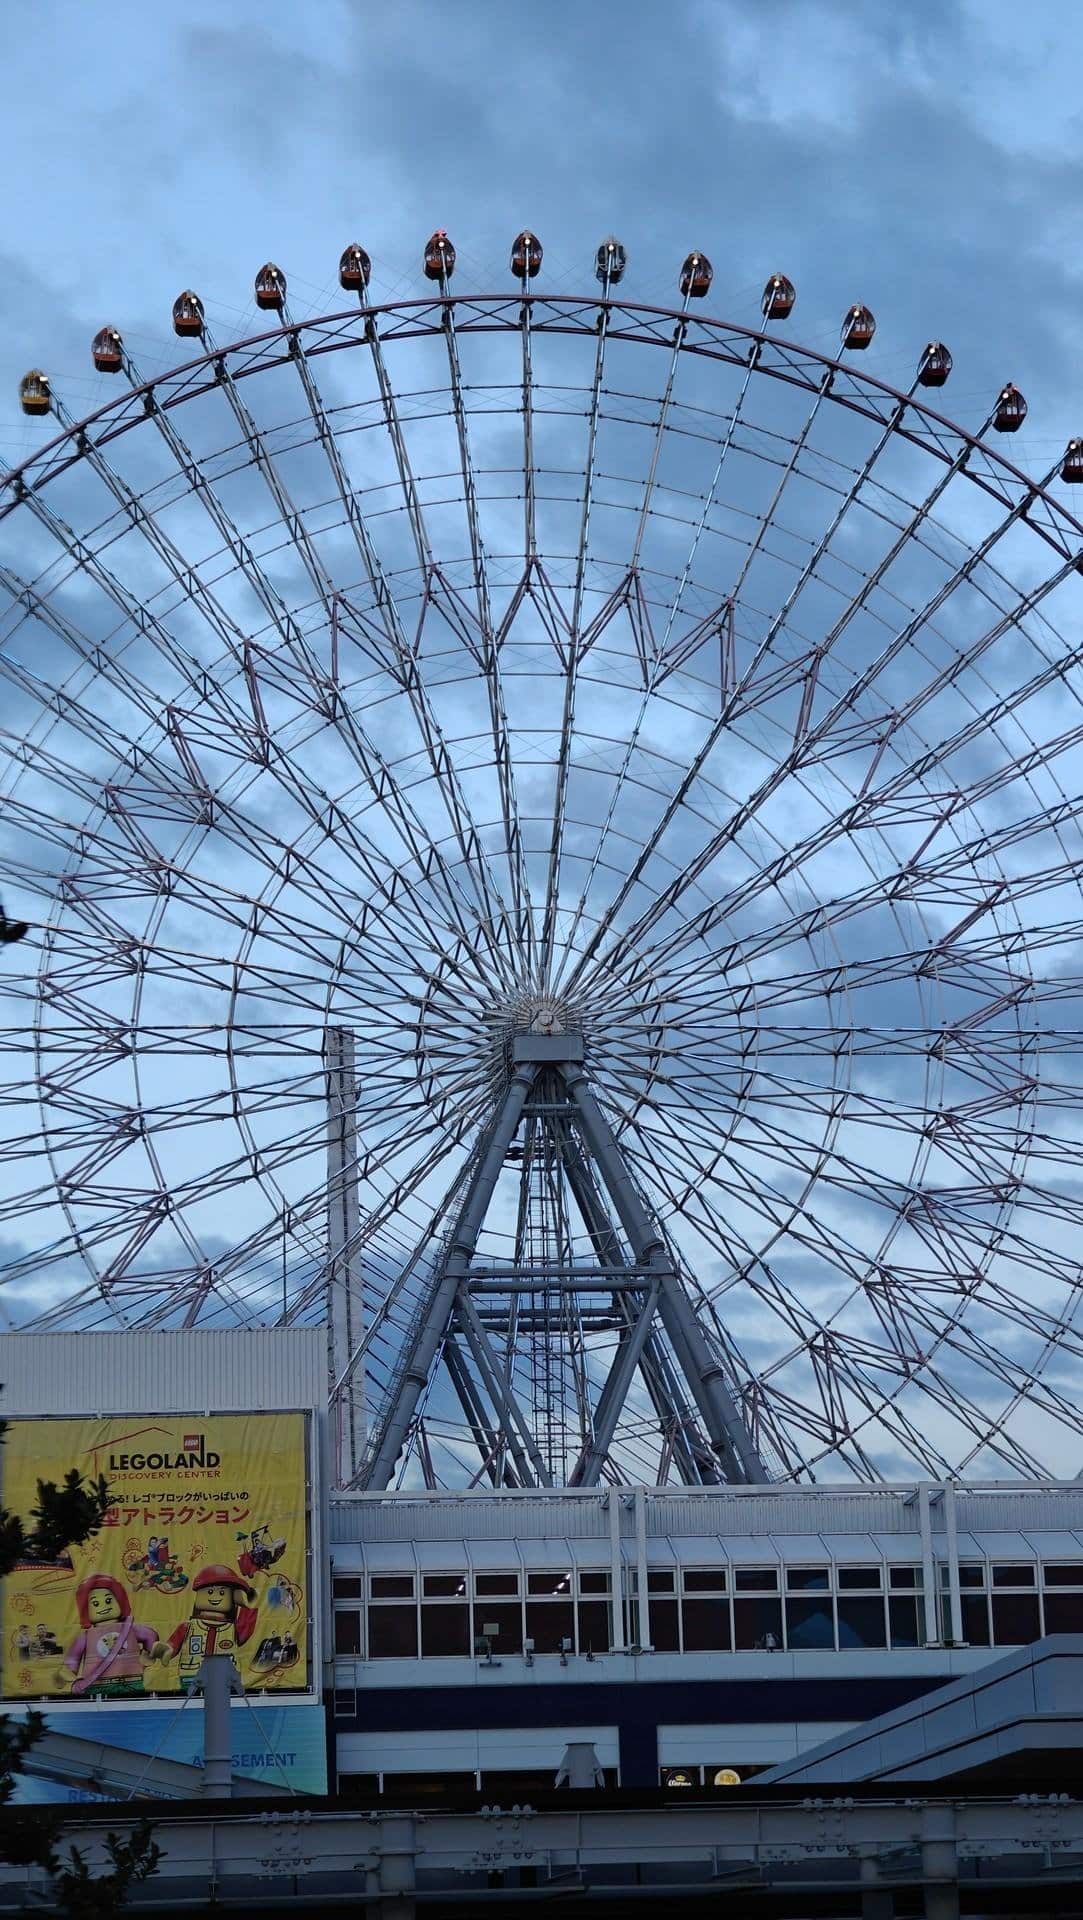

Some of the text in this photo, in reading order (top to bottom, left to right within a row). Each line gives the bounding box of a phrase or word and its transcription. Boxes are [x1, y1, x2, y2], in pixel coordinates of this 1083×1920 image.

[110, 1435, 220, 1470] LEGOLAND
[110, 1470, 221, 1481] DISCOVERY CENTER
[192, 1753, 297, 1768] ASEMENT
